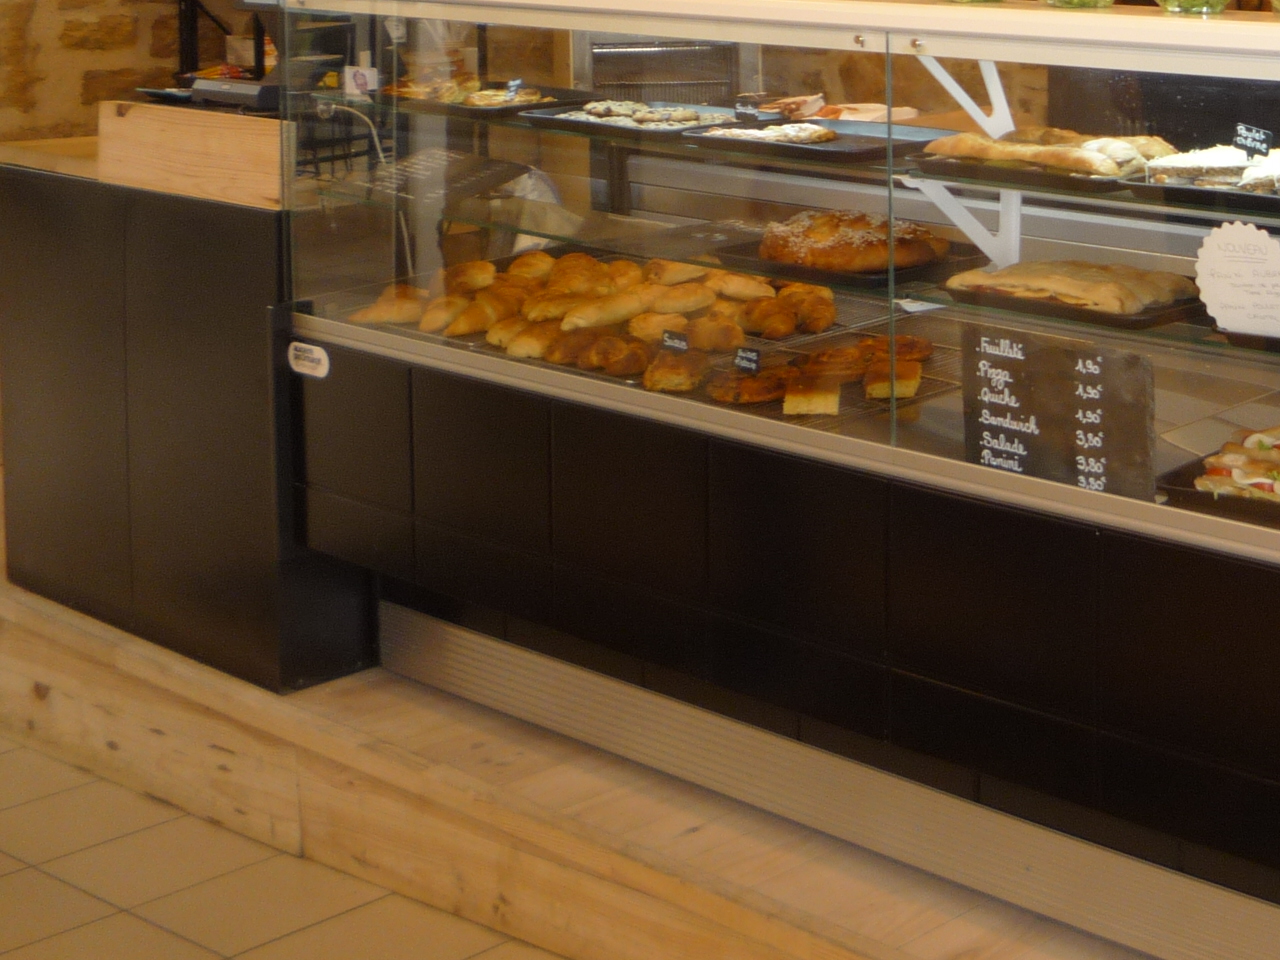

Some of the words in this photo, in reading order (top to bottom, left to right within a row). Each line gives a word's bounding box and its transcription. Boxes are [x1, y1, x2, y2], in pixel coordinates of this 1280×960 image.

[1236, 125, 1266, 141] Poulet
[978, 360, 1014, 389] Pizza
[981, 387, 1020, 407] Quiche
[981, 409, 1040, 435] Sandwich
[983, 431, 1028, 455] Salade
[981, 449, 1023, 471] Panini
